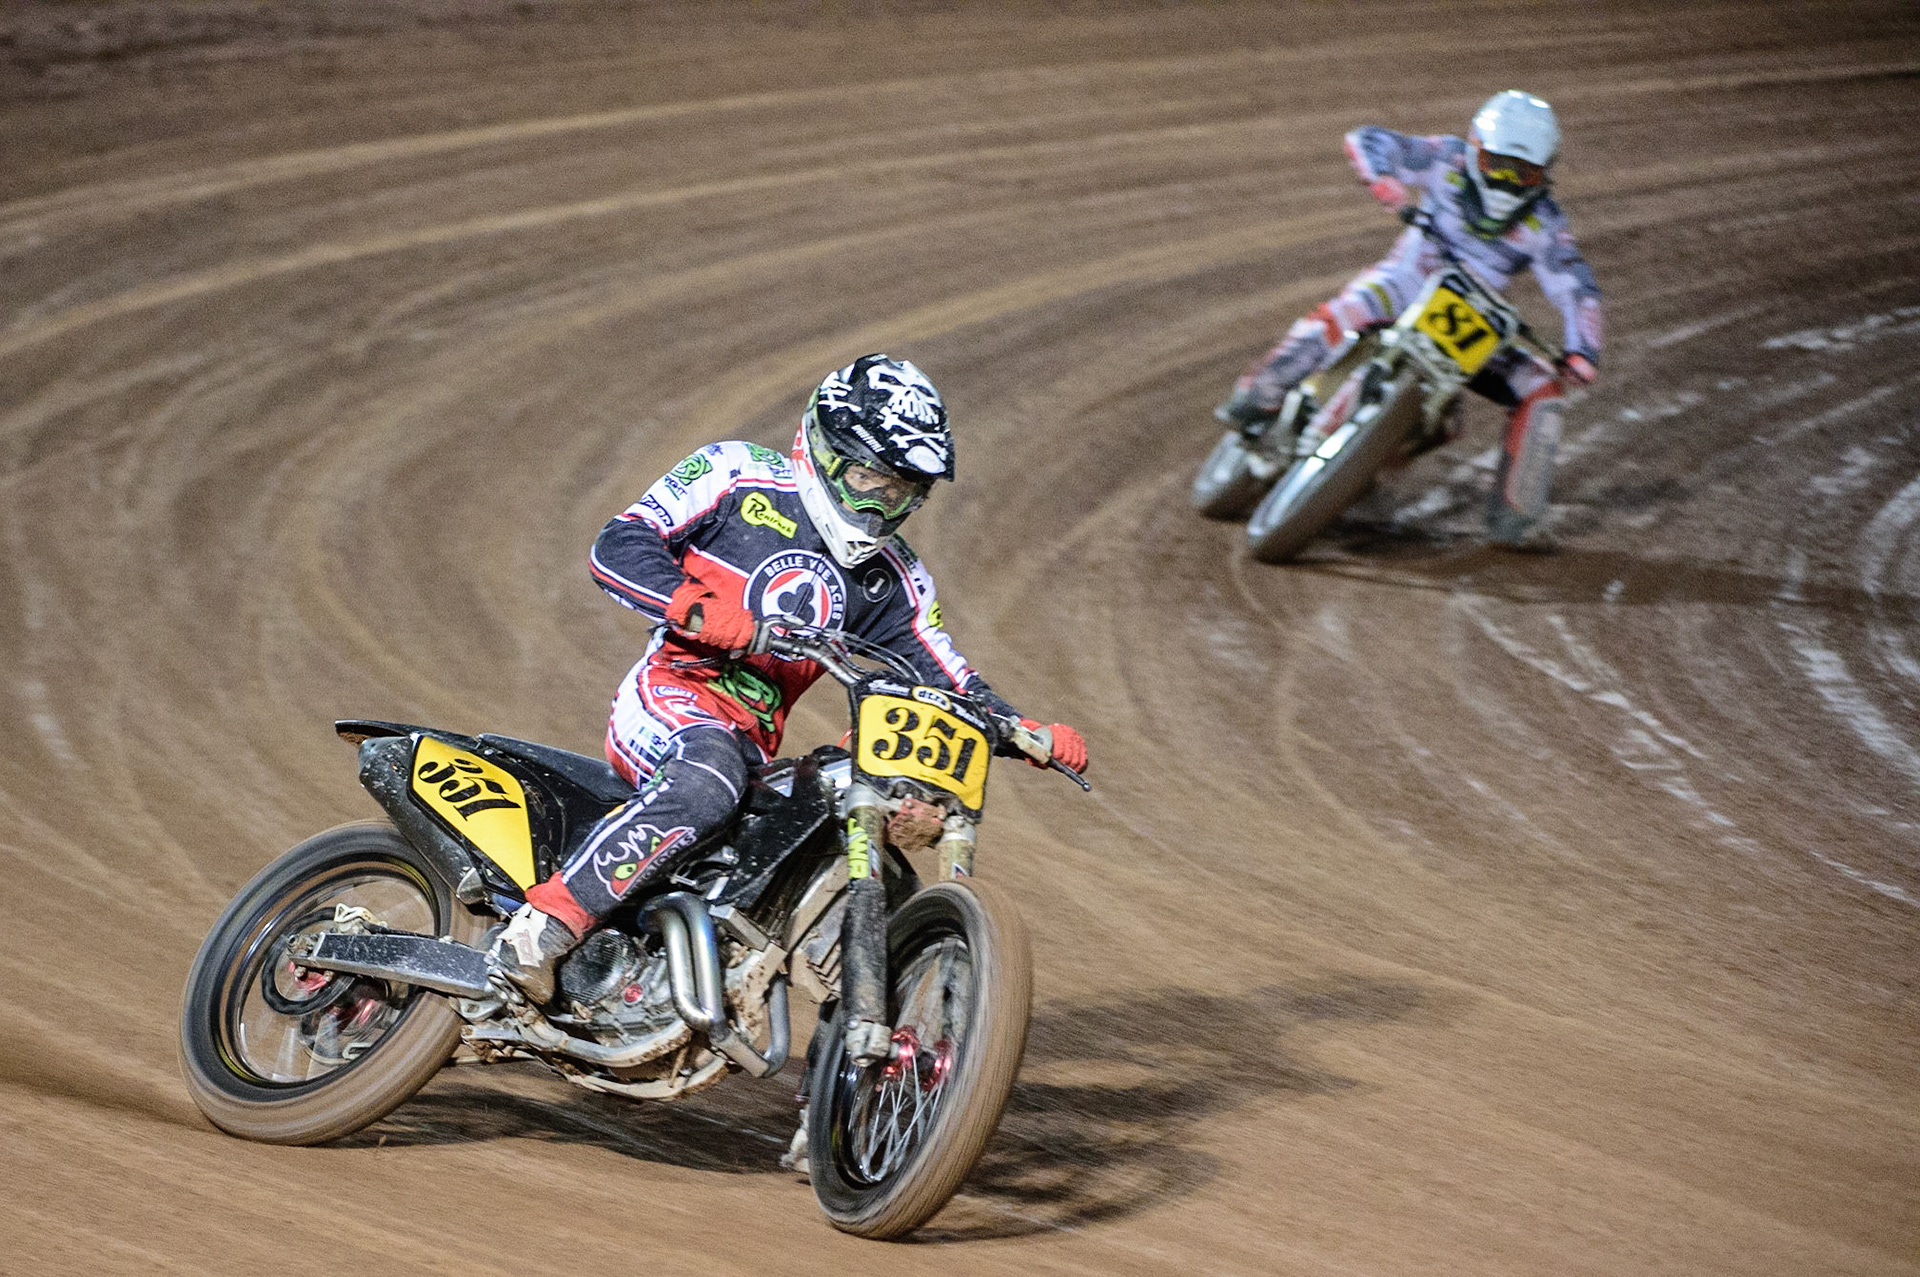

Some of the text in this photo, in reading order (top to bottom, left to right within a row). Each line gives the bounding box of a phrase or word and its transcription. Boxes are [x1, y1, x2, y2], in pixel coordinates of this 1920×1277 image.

[1428, 303, 1488, 351] 81
[764, 556, 844, 620] BELLE VUE ACES
[872, 706, 978, 787] 351
[417, 758, 522, 822] 351
